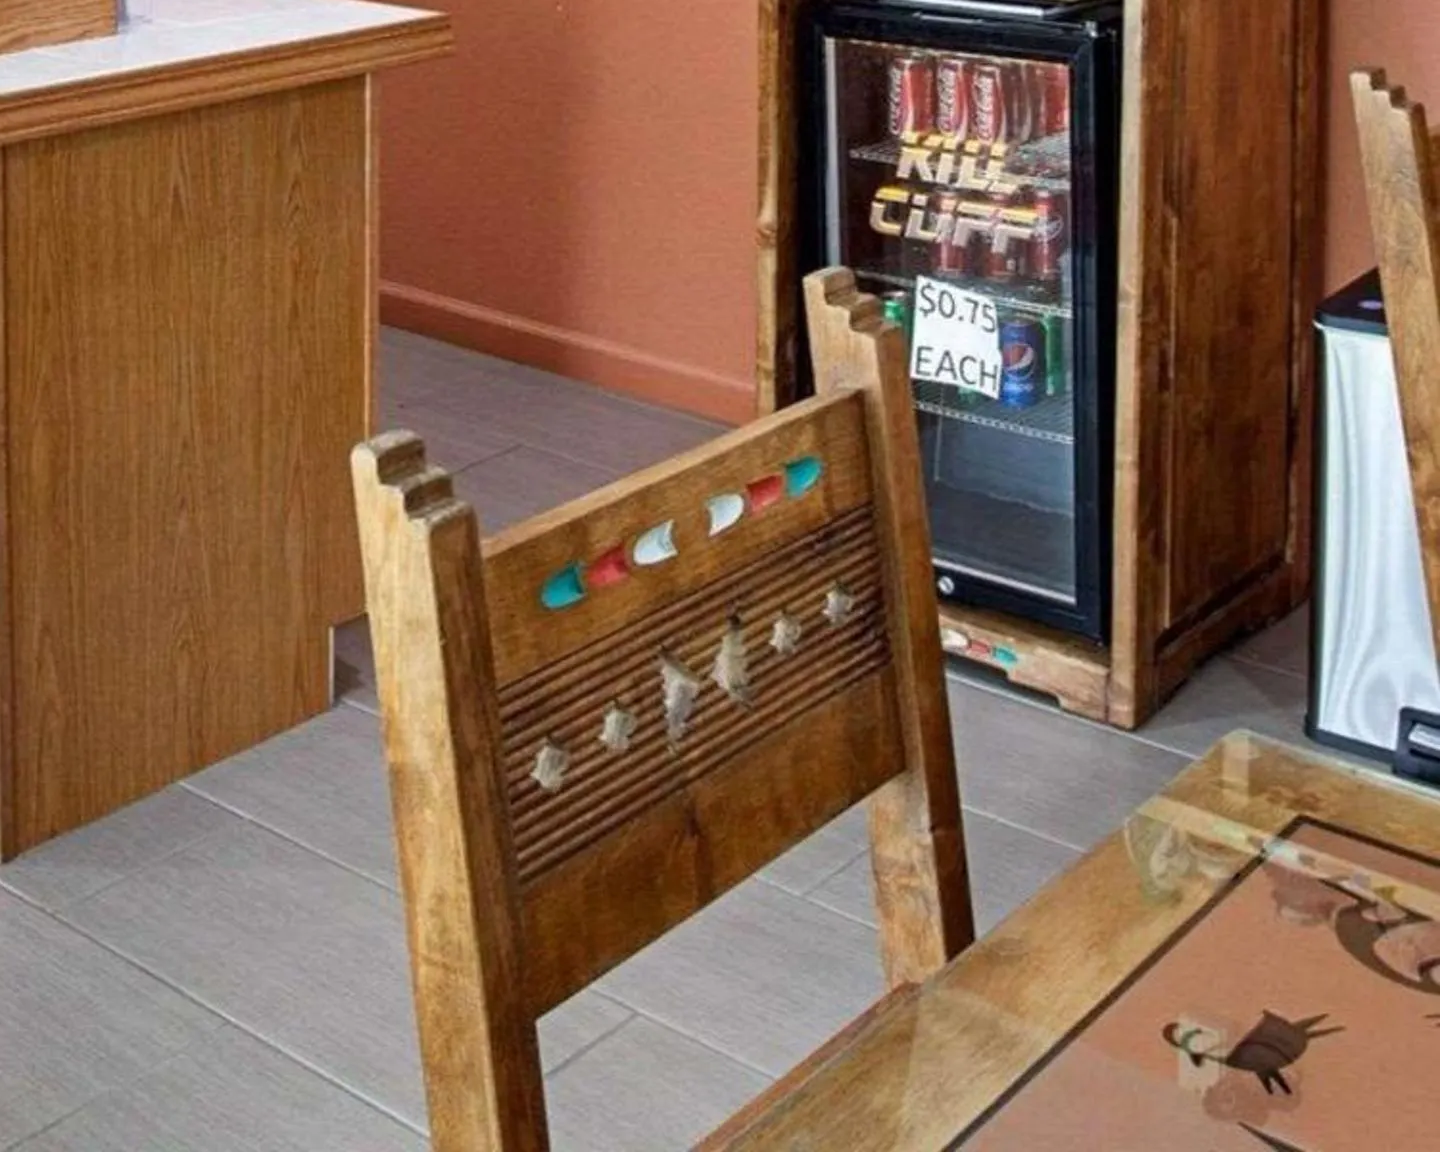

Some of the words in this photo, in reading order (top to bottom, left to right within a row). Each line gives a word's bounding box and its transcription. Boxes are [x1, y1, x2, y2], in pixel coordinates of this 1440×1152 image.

[895, 130, 1018, 194] KILL
[919, 282, 997, 334] $0.75
[915, 345, 999, 392] EACH
